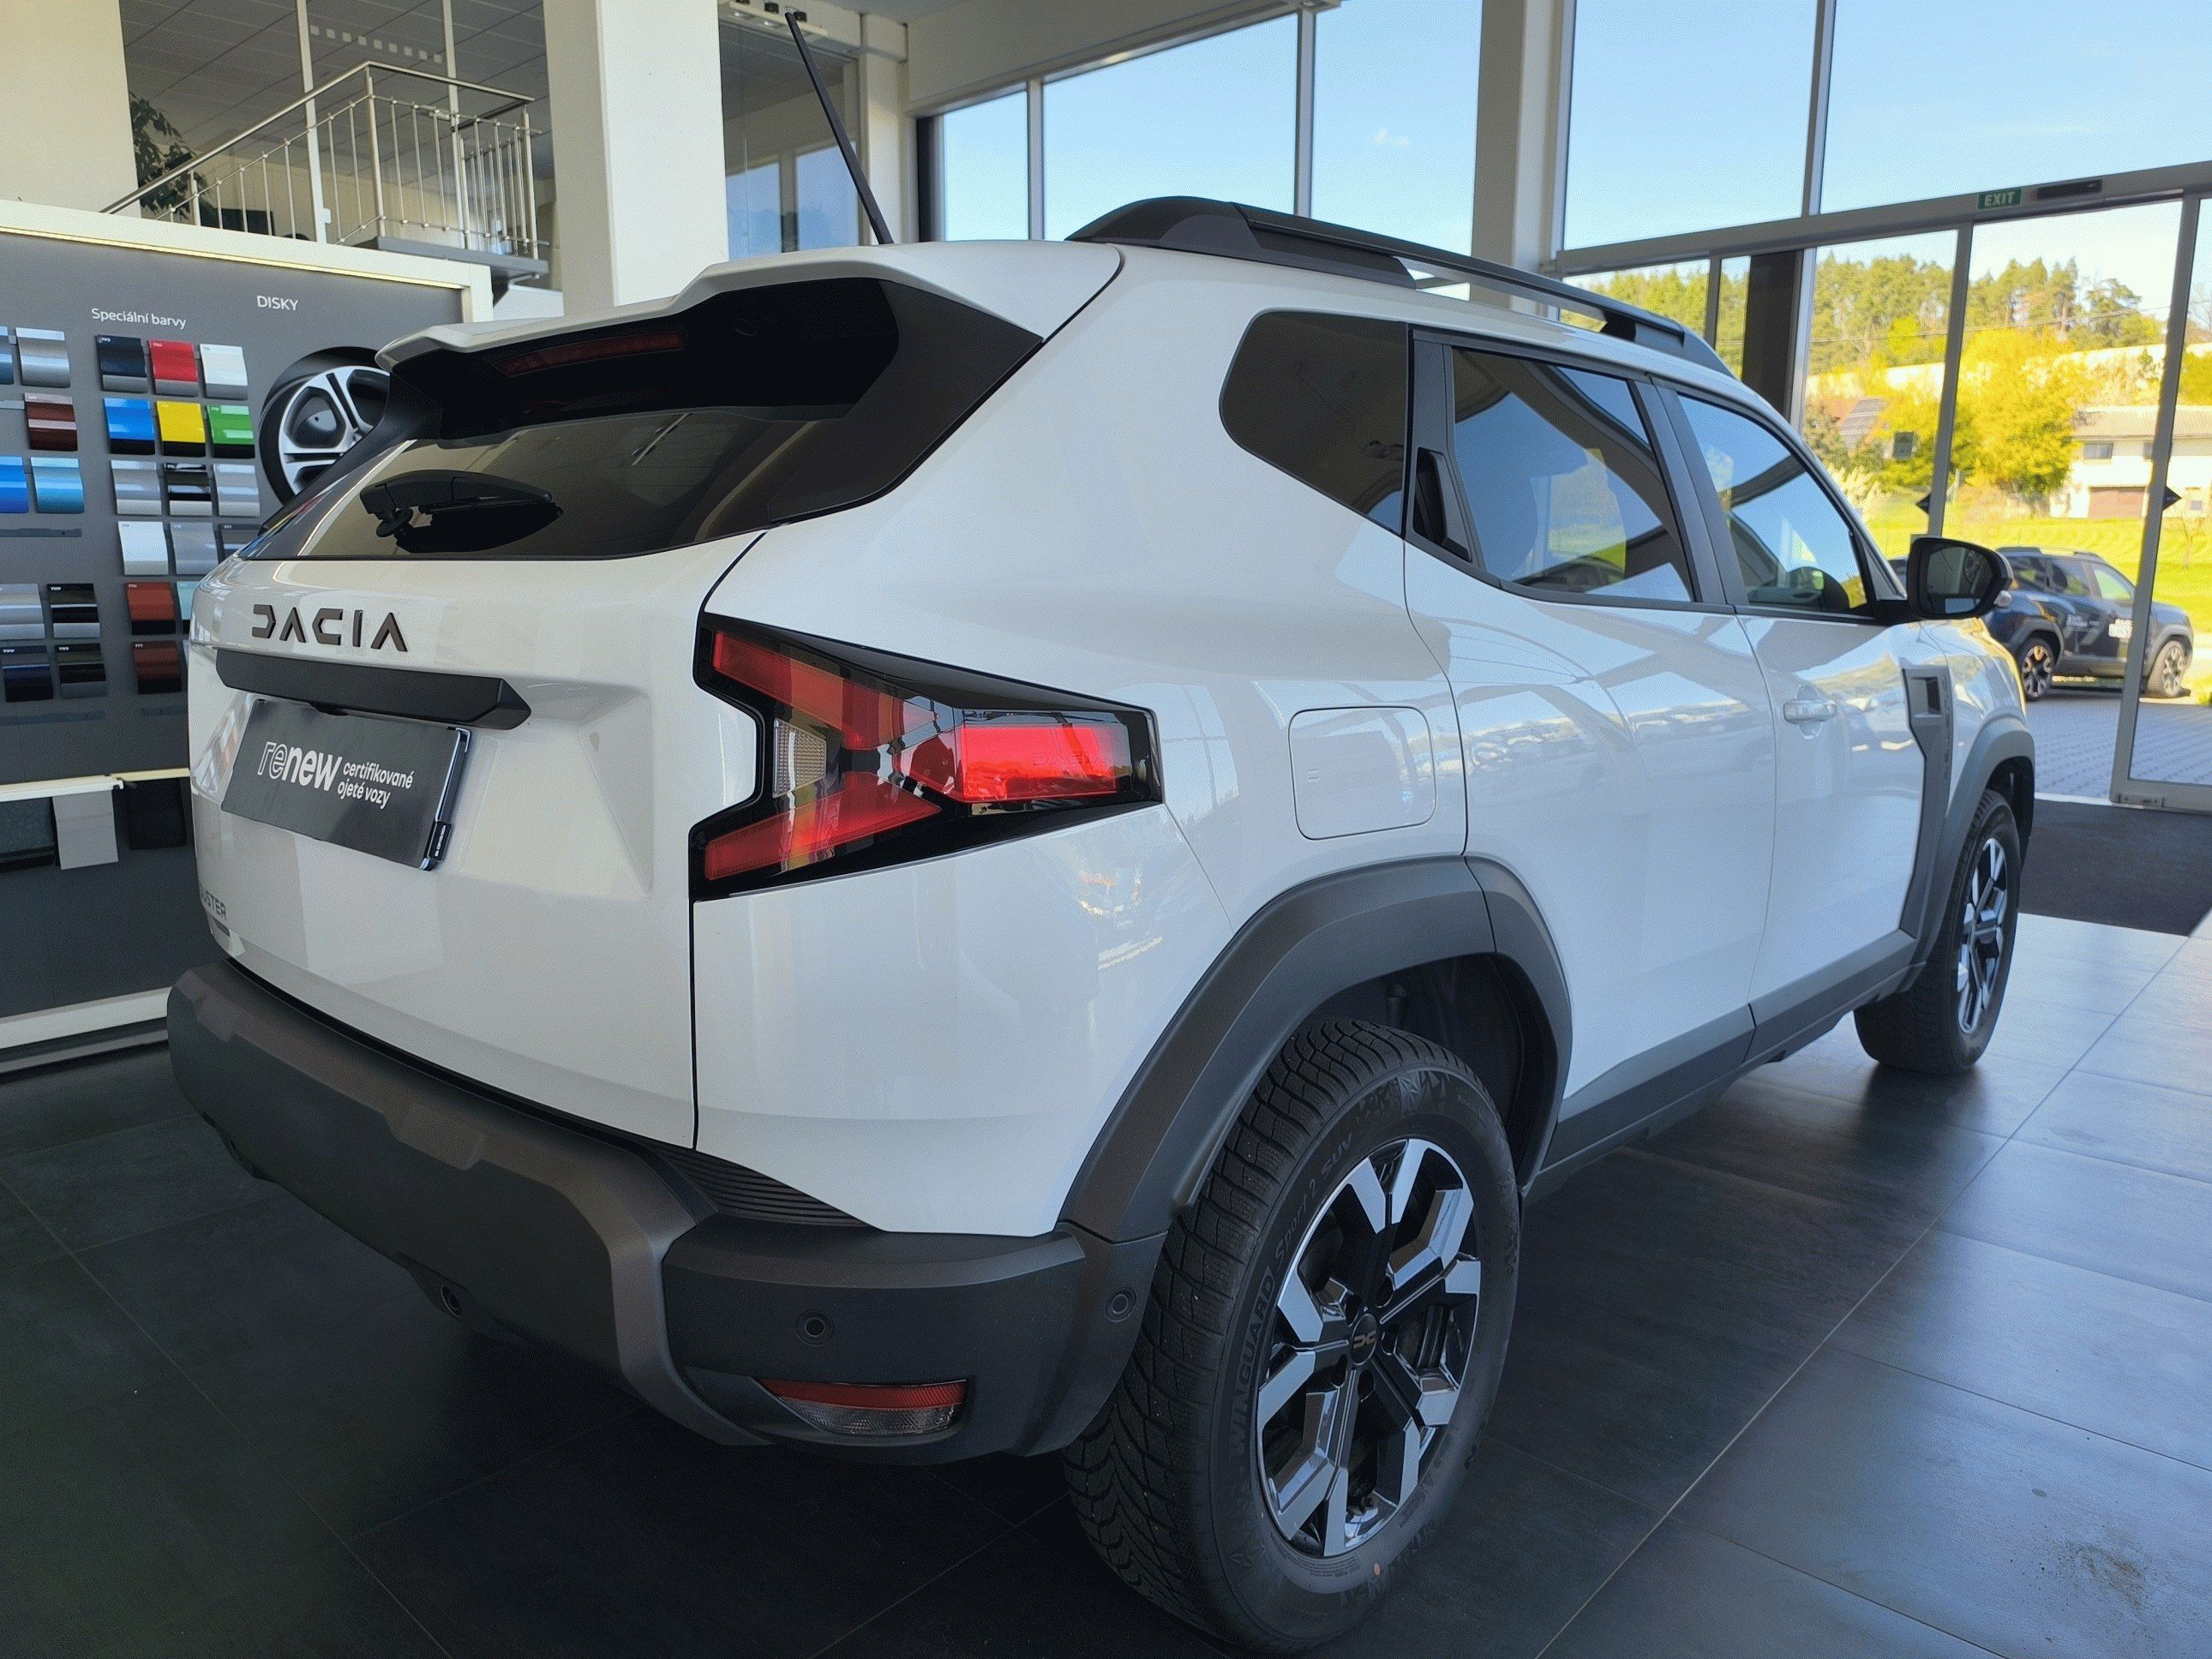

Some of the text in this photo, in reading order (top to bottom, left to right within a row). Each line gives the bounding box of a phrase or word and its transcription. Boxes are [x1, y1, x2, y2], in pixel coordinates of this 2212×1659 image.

[1984, 191, 2015, 207] EXIT
[256, 295, 299, 311] DISKY
[91, 308, 187, 330] Speciální barvy
[251, 603, 409, 653] DACIA
[257, 740, 343, 792] renew
[343, 761, 414, 789] certifikované
[337, 778, 392, 810] ojeté vozy
[1274, 1193, 1308, 1272] Sport
[1320, 1131, 1353, 1181] SUV
